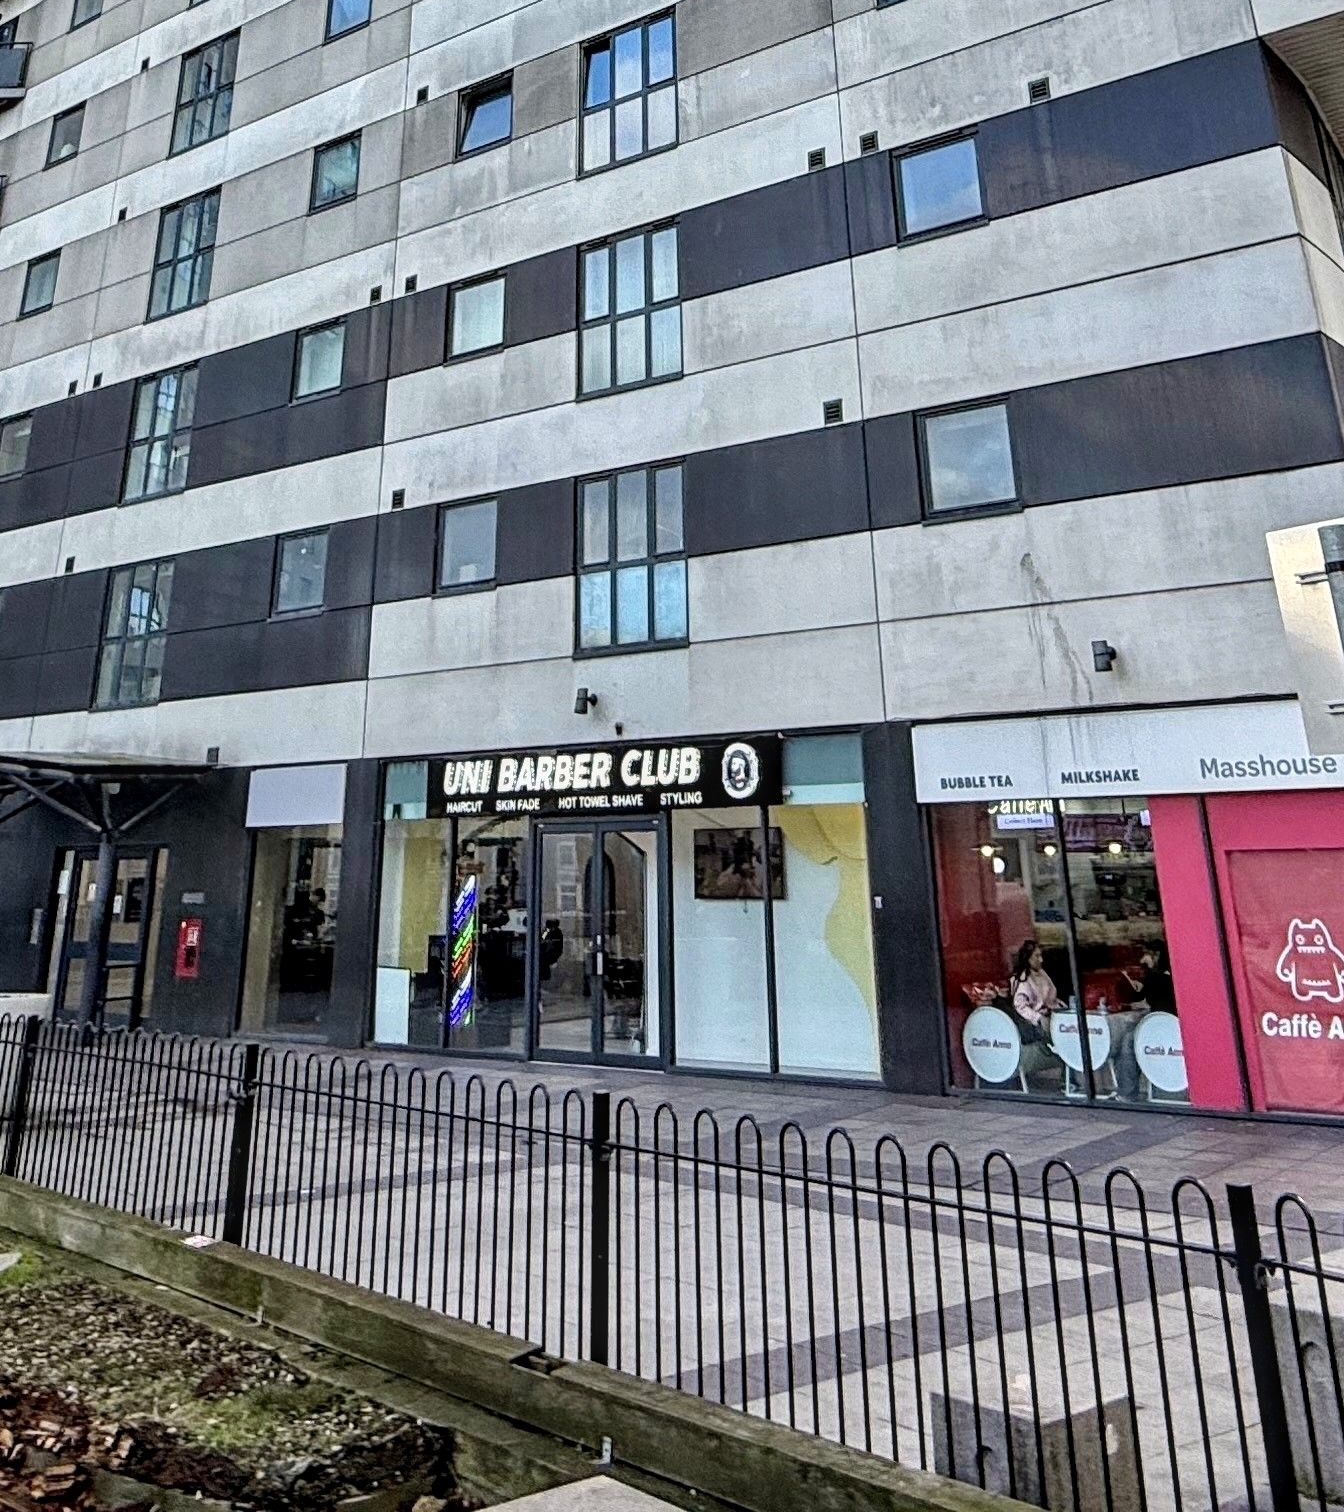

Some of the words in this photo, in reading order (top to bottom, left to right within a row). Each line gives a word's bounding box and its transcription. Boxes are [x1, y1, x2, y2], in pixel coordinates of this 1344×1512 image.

[443, 759, 493, 796] UNI
[497, 752, 613, 793] BARBER
[620, 746, 701, 787] CLUB
[1199, 754, 1338, 780] Masshouse
[940, 777, 986, 790] BUBBLE
[990, 775, 1014, 788] TEA
[1060, 768, 1140, 785] MILKSHAKE
[495, 799, 516, 812] SKIN
[517, 798, 540, 811] FADE
[558, 796, 578, 809] HOT
[578, 795, 611, 808] TOWEL
[612, 793, 644, 807] SHAVE
[660, 791, 703, 806] STYLING
[446, 800, 483, 814] HAIRCUT
[1261, 1011, 1322, 1039] Caffè
